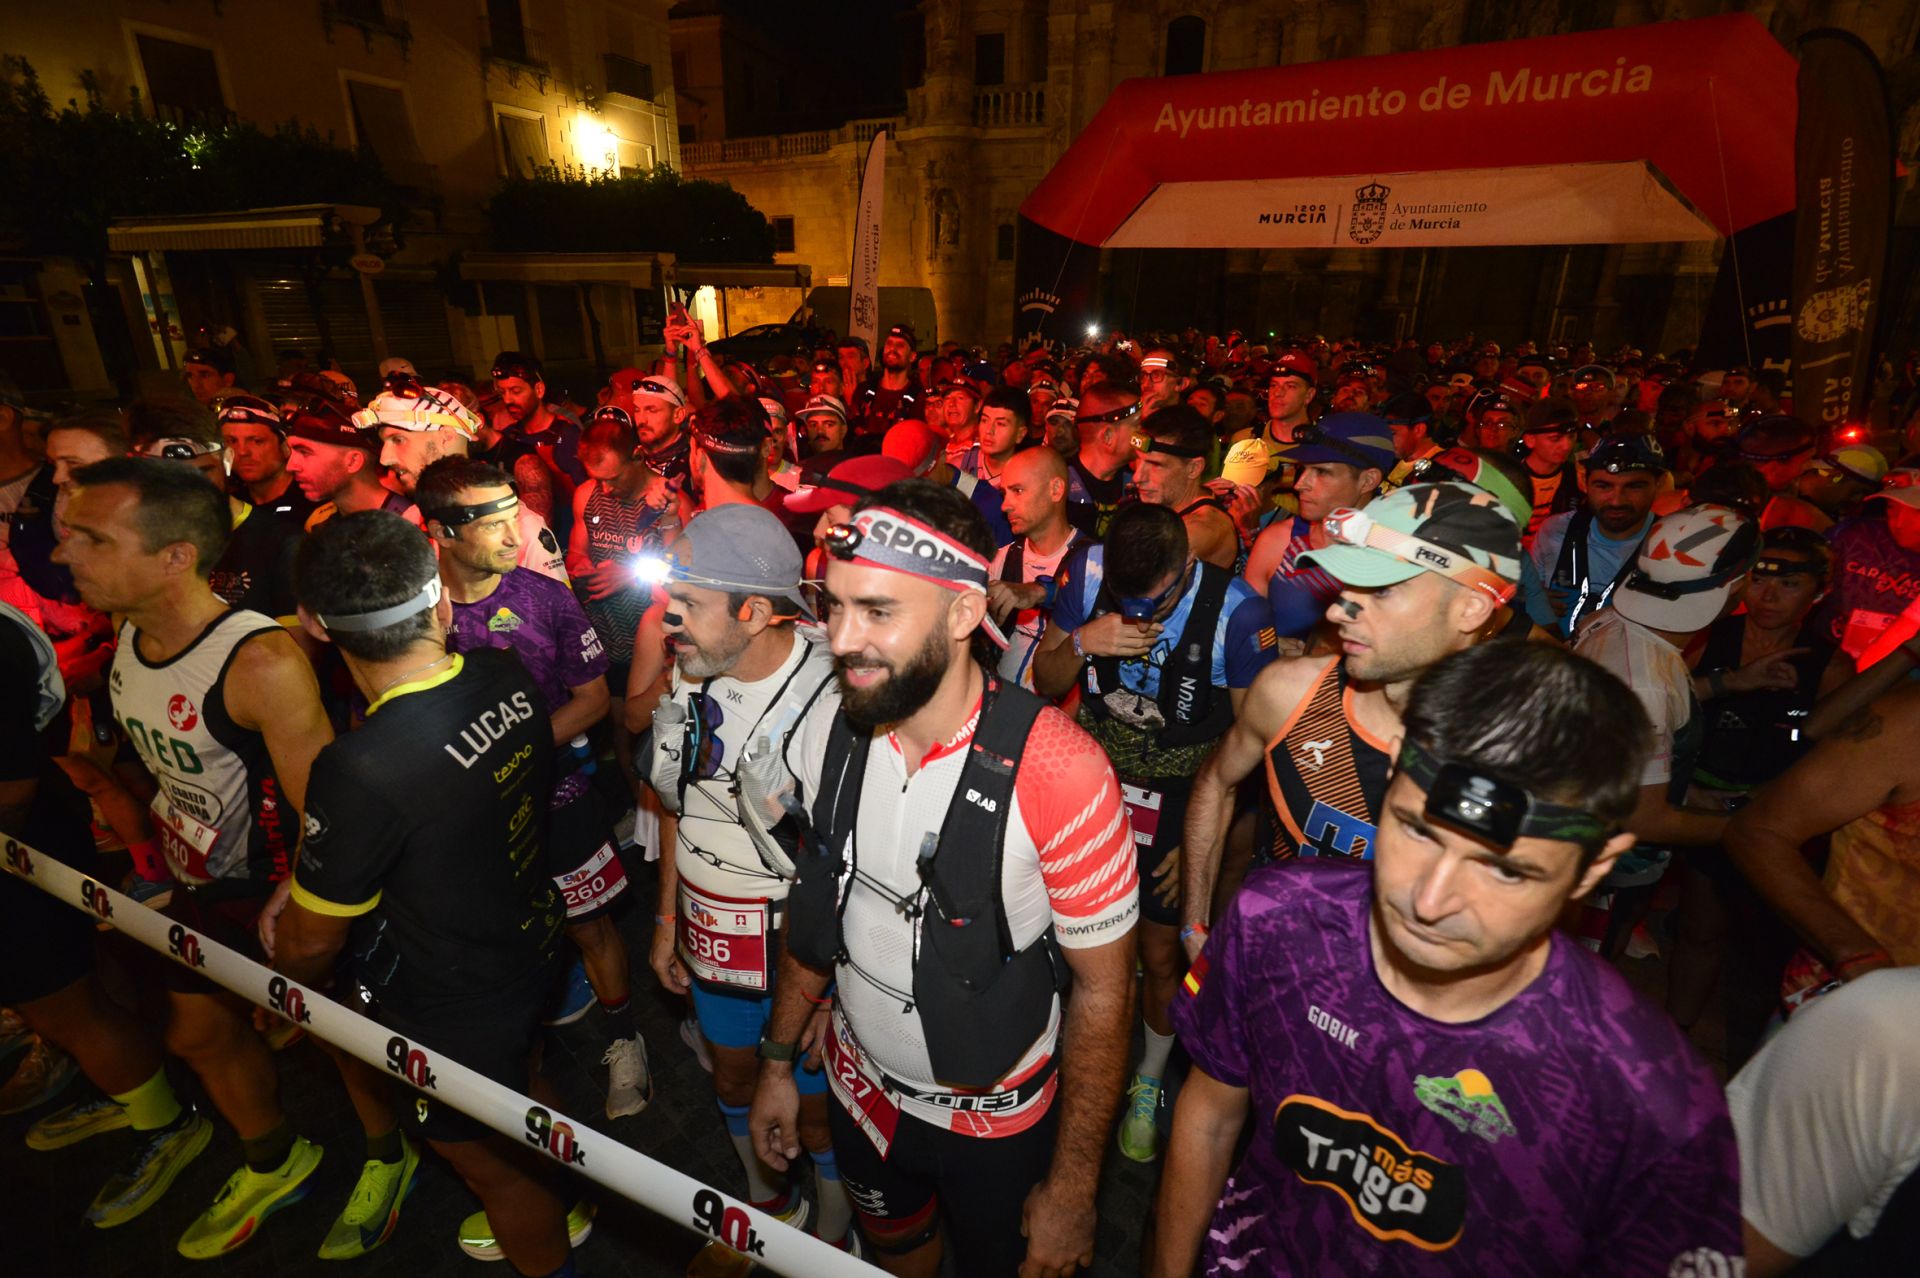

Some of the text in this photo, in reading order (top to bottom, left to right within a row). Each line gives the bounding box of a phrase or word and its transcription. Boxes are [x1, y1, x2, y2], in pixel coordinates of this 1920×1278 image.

[1153, 56, 1654, 140] Ayuntamiento de Murcia
[1258, 213, 1327, 224] MURCIA
[1295, 204, 1326, 212] 1200
[1389, 217, 1461, 231] de Murcia
[1392, 202, 1487, 218] Ayuntamiento
[1415, 546, 1450, 568] PETZL
[1176, 676, 1198, 722] PRUN
[443, 690, 534, 770] LUCAS
[5, 839, 35, 876] 90k
[81, 879, 114, 919] 90k
[563, 876, 606, 905] 260
[168, 924, 205, 968] 90k
[688, 926, 731, 963] 536
[268, 976, 311, 1024] 90k
[1307, 1004, 1360, 1049] GOBIK
[386, 1036, 437, 1089] 90k
[834, 1046, 872, 1099] 127
[525, 1106, 586, 1167] 90k
[1299, 1124, 1428, 1215] Trigo
[1373, 1145, 1435, 1191] más
[692, 1188, 765, 1257] 90k
